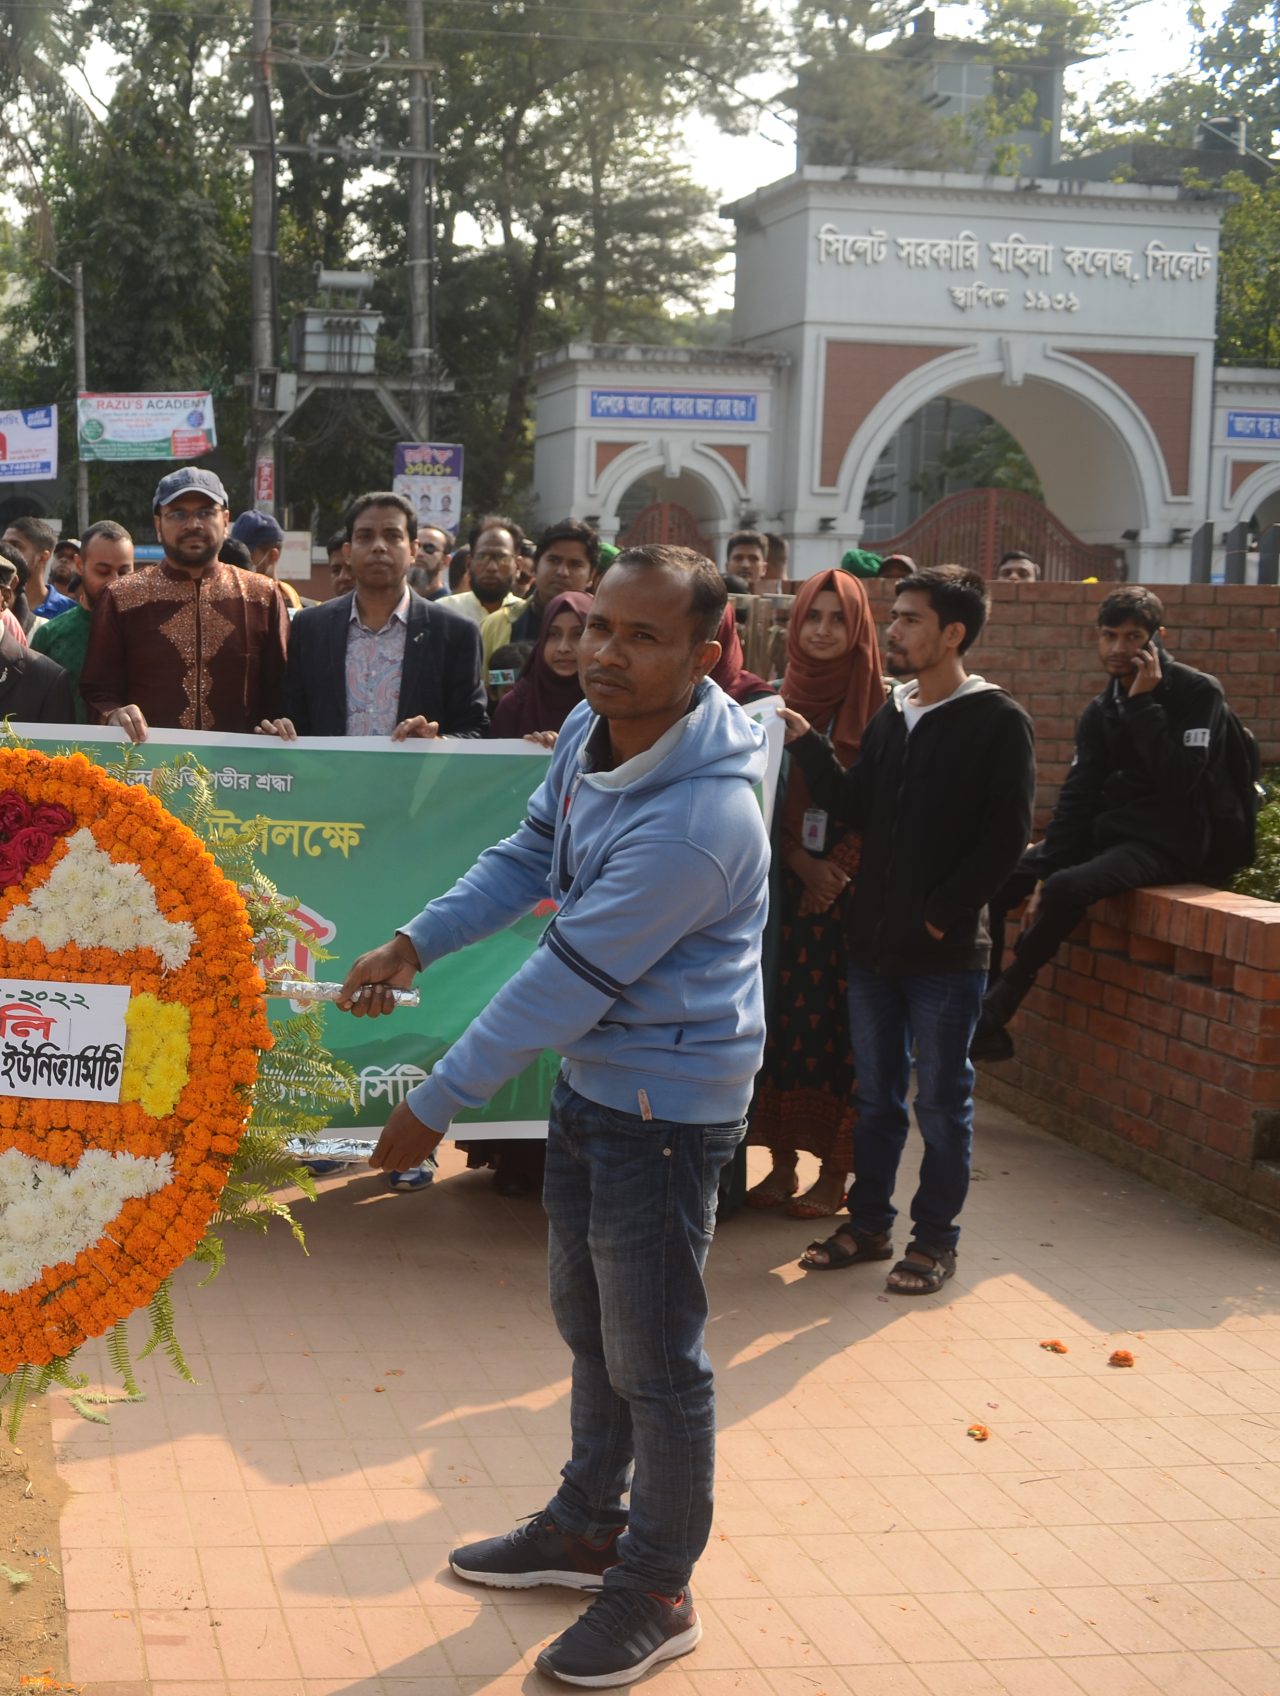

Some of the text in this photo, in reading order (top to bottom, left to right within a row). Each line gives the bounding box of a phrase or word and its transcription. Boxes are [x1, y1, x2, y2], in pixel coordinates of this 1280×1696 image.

[817, 223, 888, 266] সিলেট
[896, 230, 979, 271] সরকারি
[988, 233, 1053, 276] মহিলা
[1144, 240, 1212, 282] সিলেট
[1024, 288, 1081, 313] ১৯৩৯
[96, 399, 143, 410] RAZU'S
[256, 773, 294, 793] শ্রদ্ধা
[0, 1039, 124, 1091] ইউনিভার্সিটি
